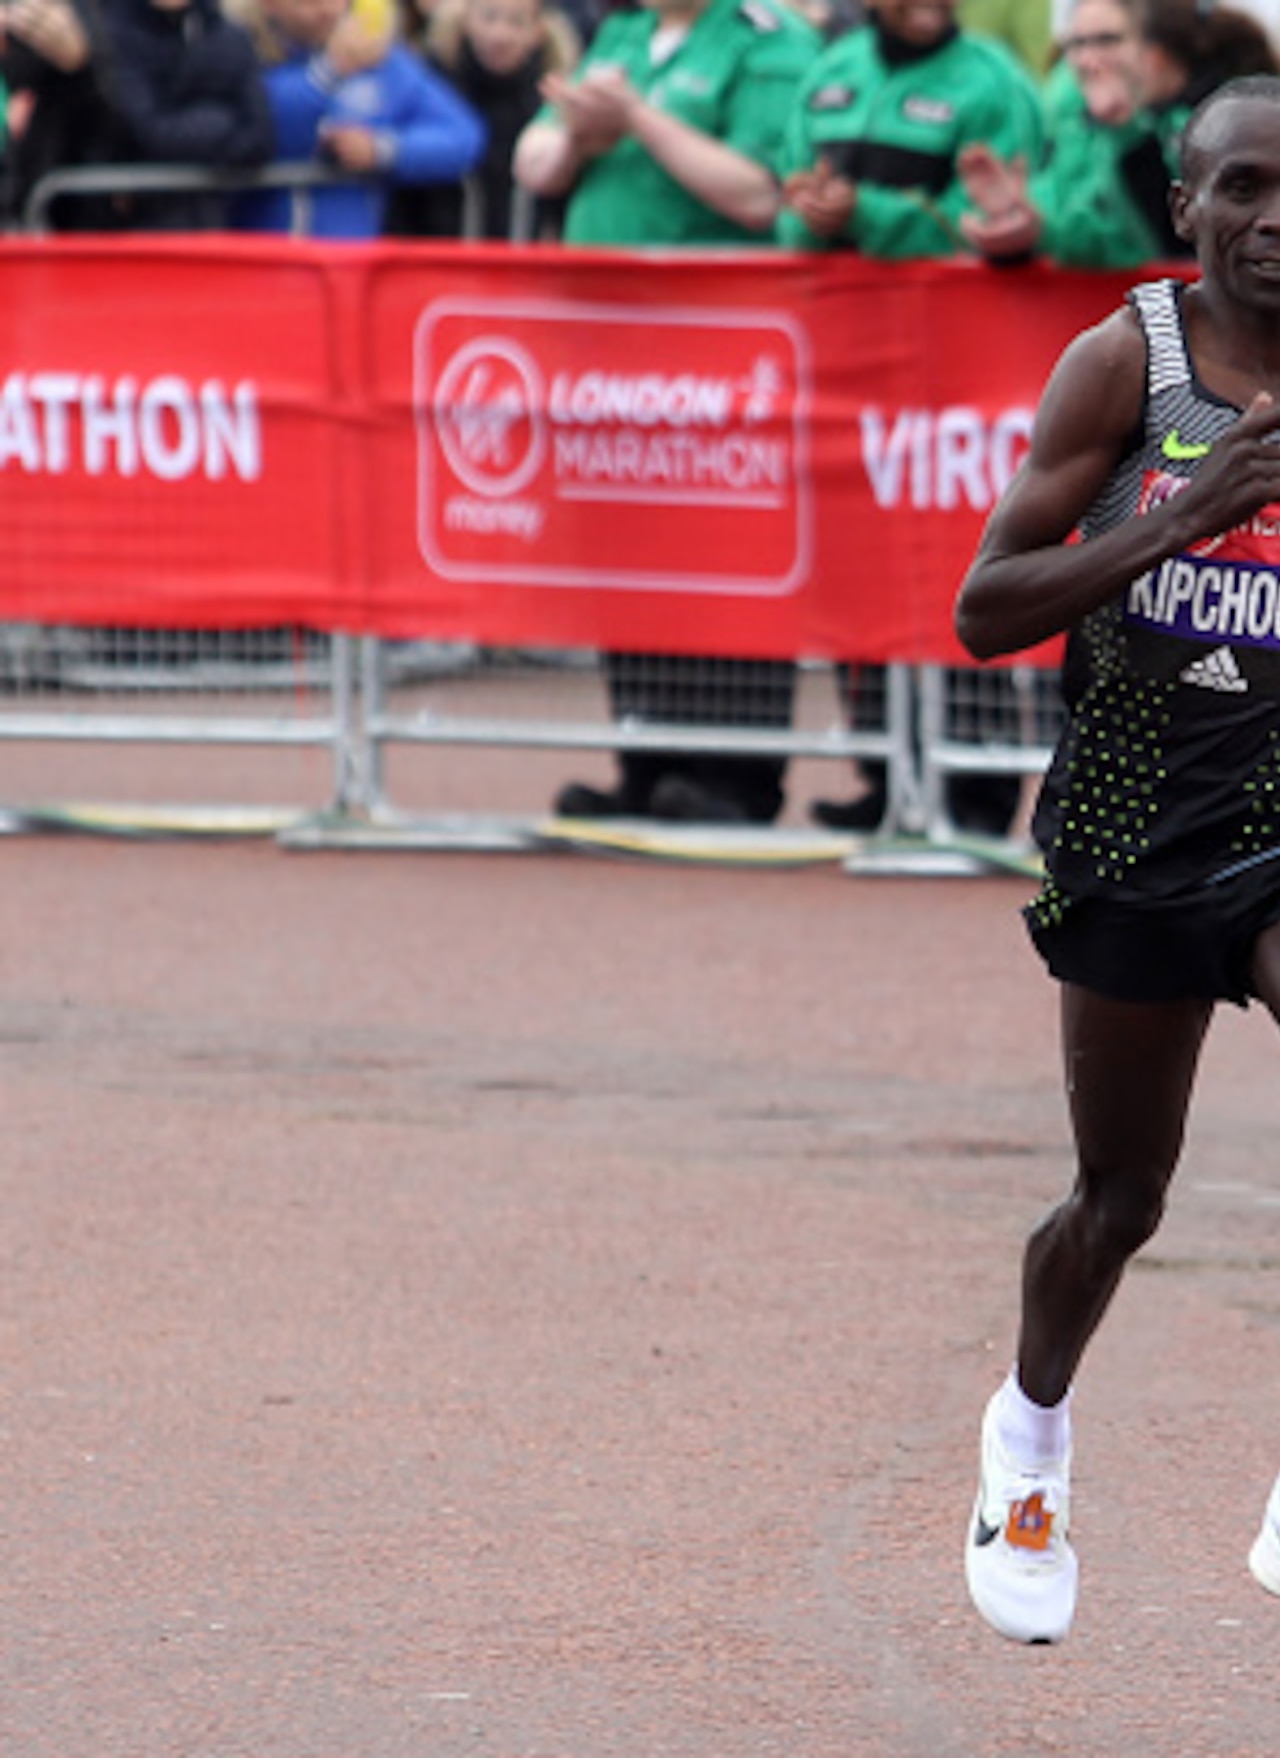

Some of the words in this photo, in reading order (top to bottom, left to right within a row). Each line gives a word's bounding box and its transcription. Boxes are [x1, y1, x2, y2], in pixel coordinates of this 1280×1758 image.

[0, 372, 262, 482] ATHON
[549, 371, 731, 425] LONDON
[553, 429, 785, 487] MARATHON
